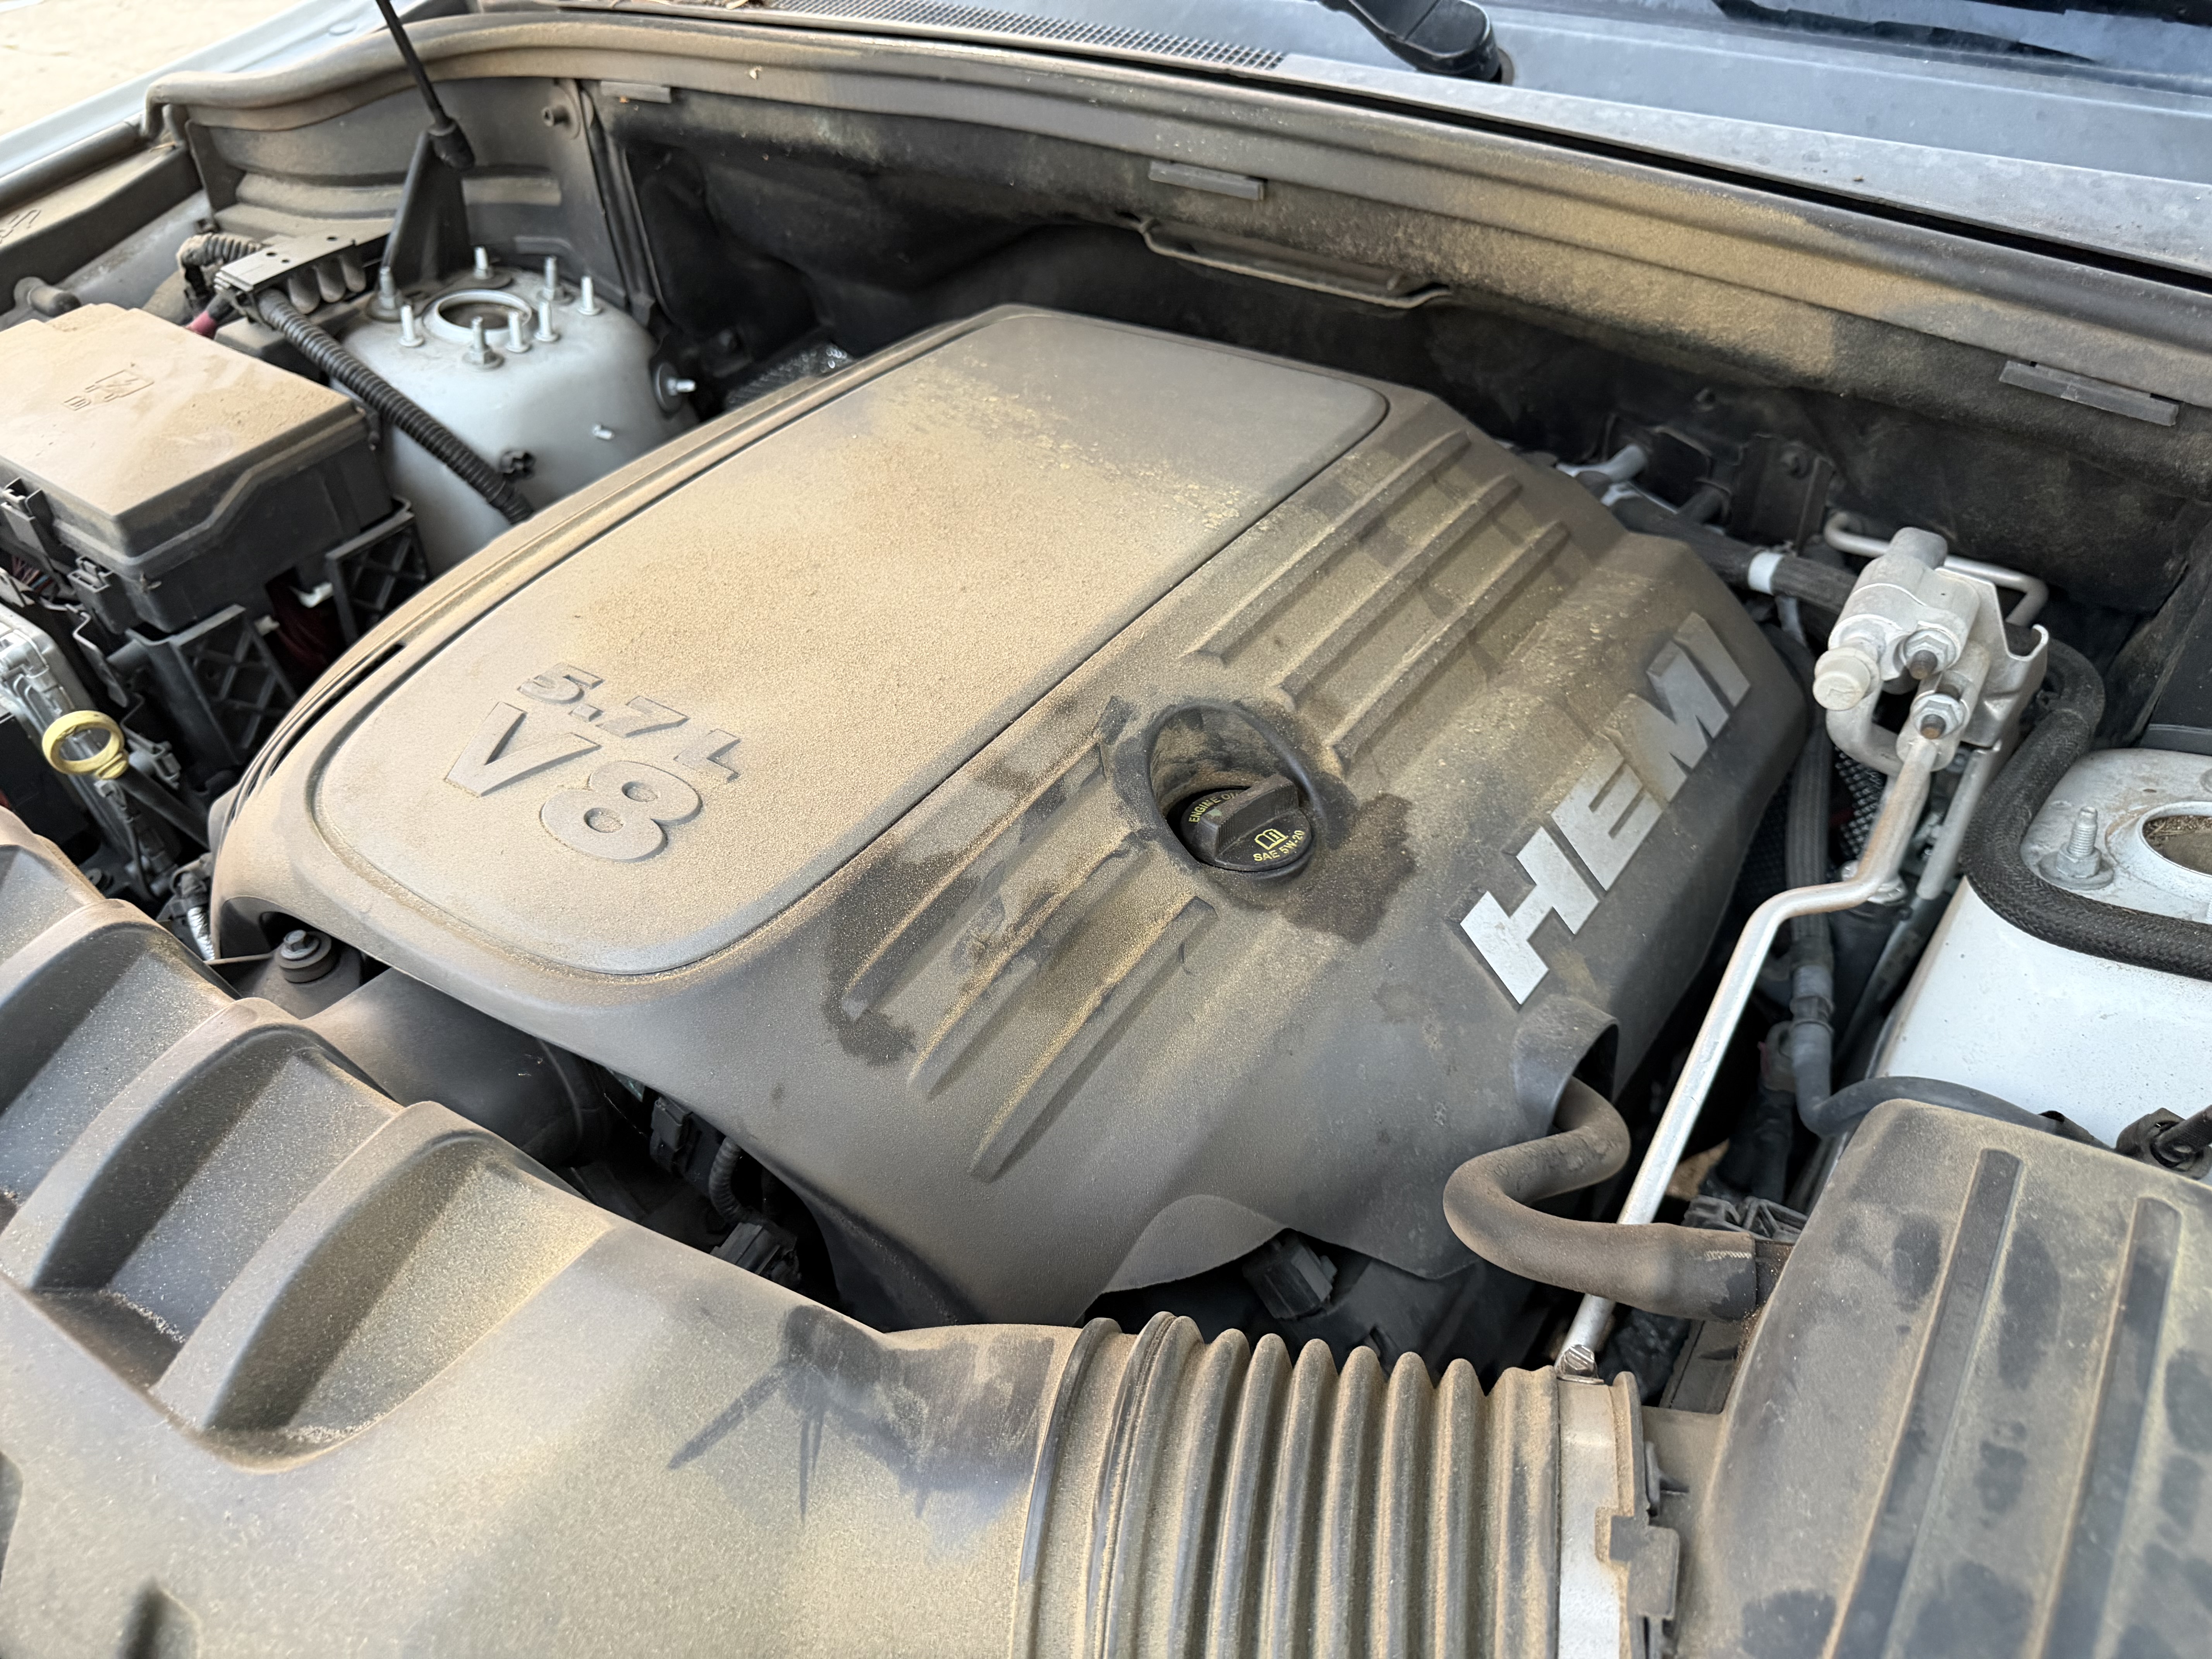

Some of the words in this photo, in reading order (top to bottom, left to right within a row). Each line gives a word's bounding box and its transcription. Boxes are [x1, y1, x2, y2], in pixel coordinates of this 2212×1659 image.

[444, 701, 703, 863] V8
[518, 662, 741, 782] 5.7L
[1188, 796, 1221, 823] ENGINE
[1253, 850, 1280, 861] SAE
[1279, 830, 1305, 854] 5W-20
[1460, 612, 1751, 1005] HEMI
